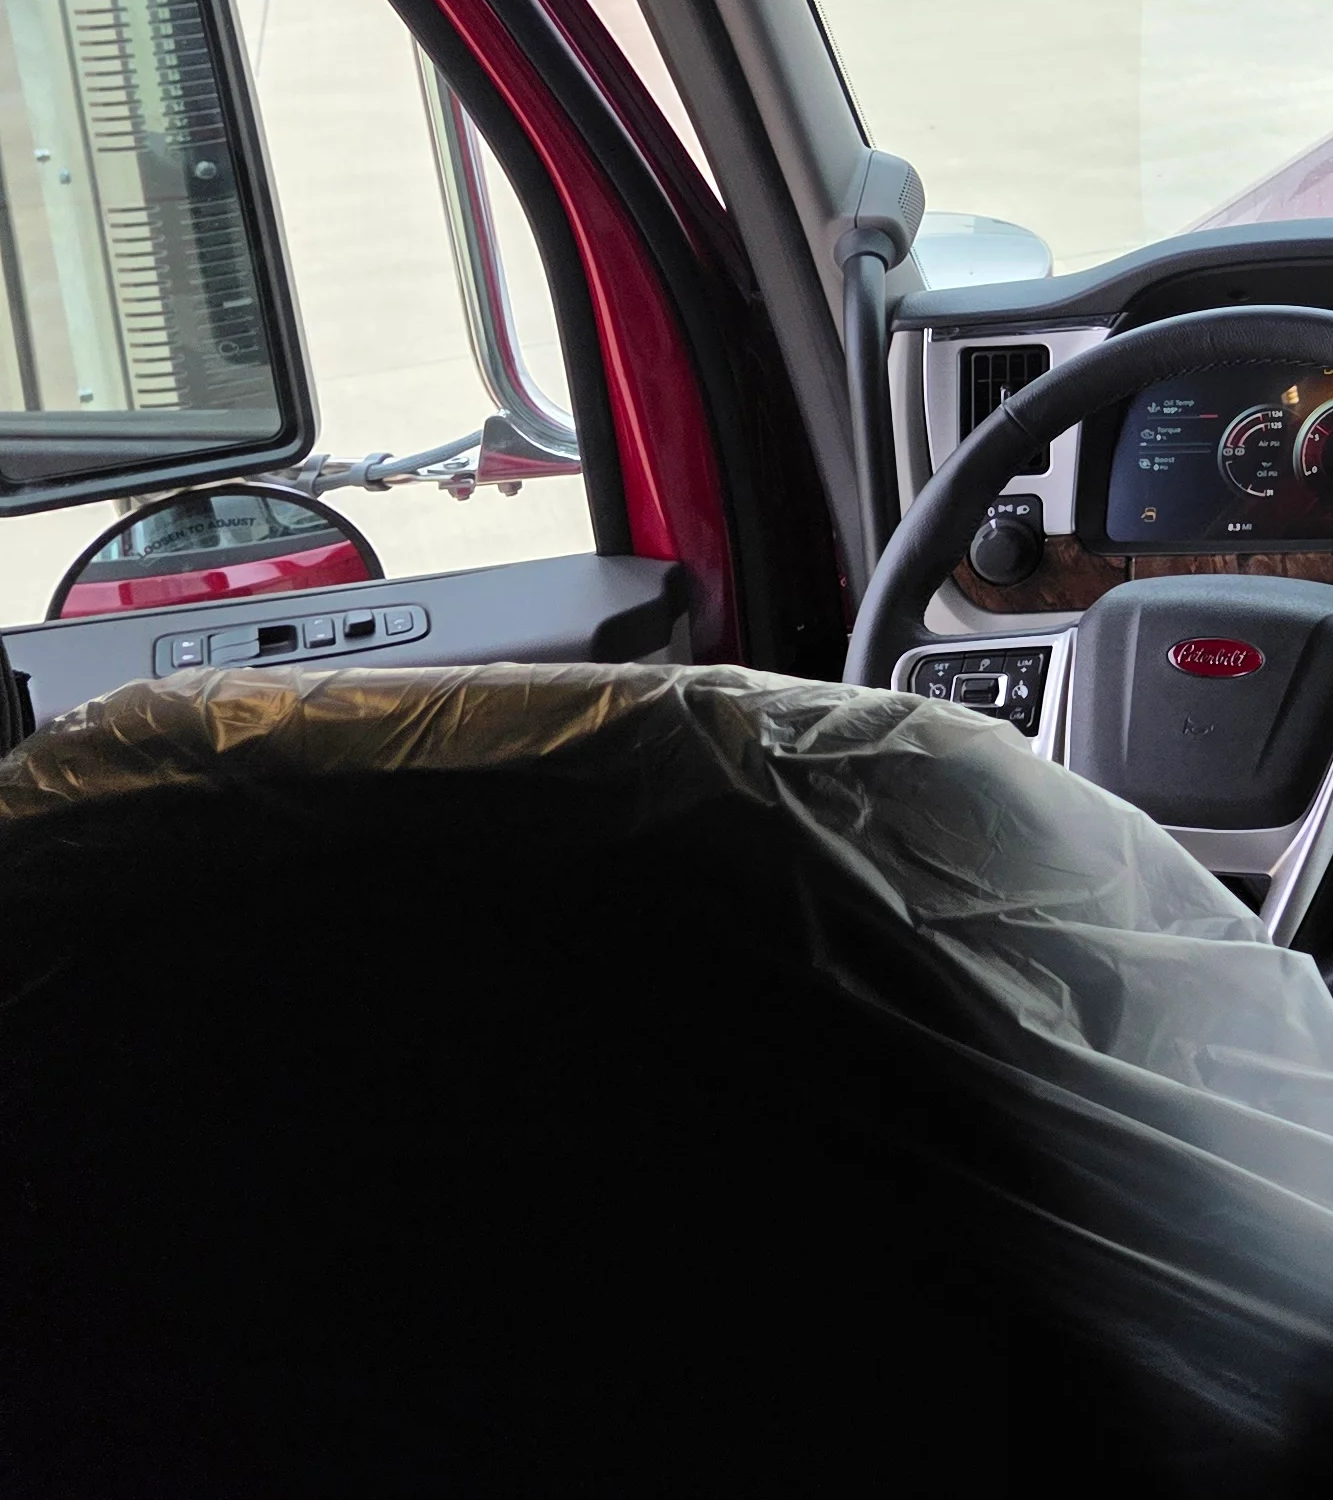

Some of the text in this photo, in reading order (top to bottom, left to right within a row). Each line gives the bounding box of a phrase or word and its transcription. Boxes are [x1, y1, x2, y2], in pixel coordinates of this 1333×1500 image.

[1157, 427, 1182, 435] Torque
[1314, 434, 1320, 442] 5
[1311, 465, 1318, 473] 0
[188, 523, 204, 534] TO
[207, 517, 256, 530] ADJUST
[1177, 643, 1247, 667] Peterbilt
[934, 663, 950, 671] SET
[1017, 659, 1033, 667] LIM
